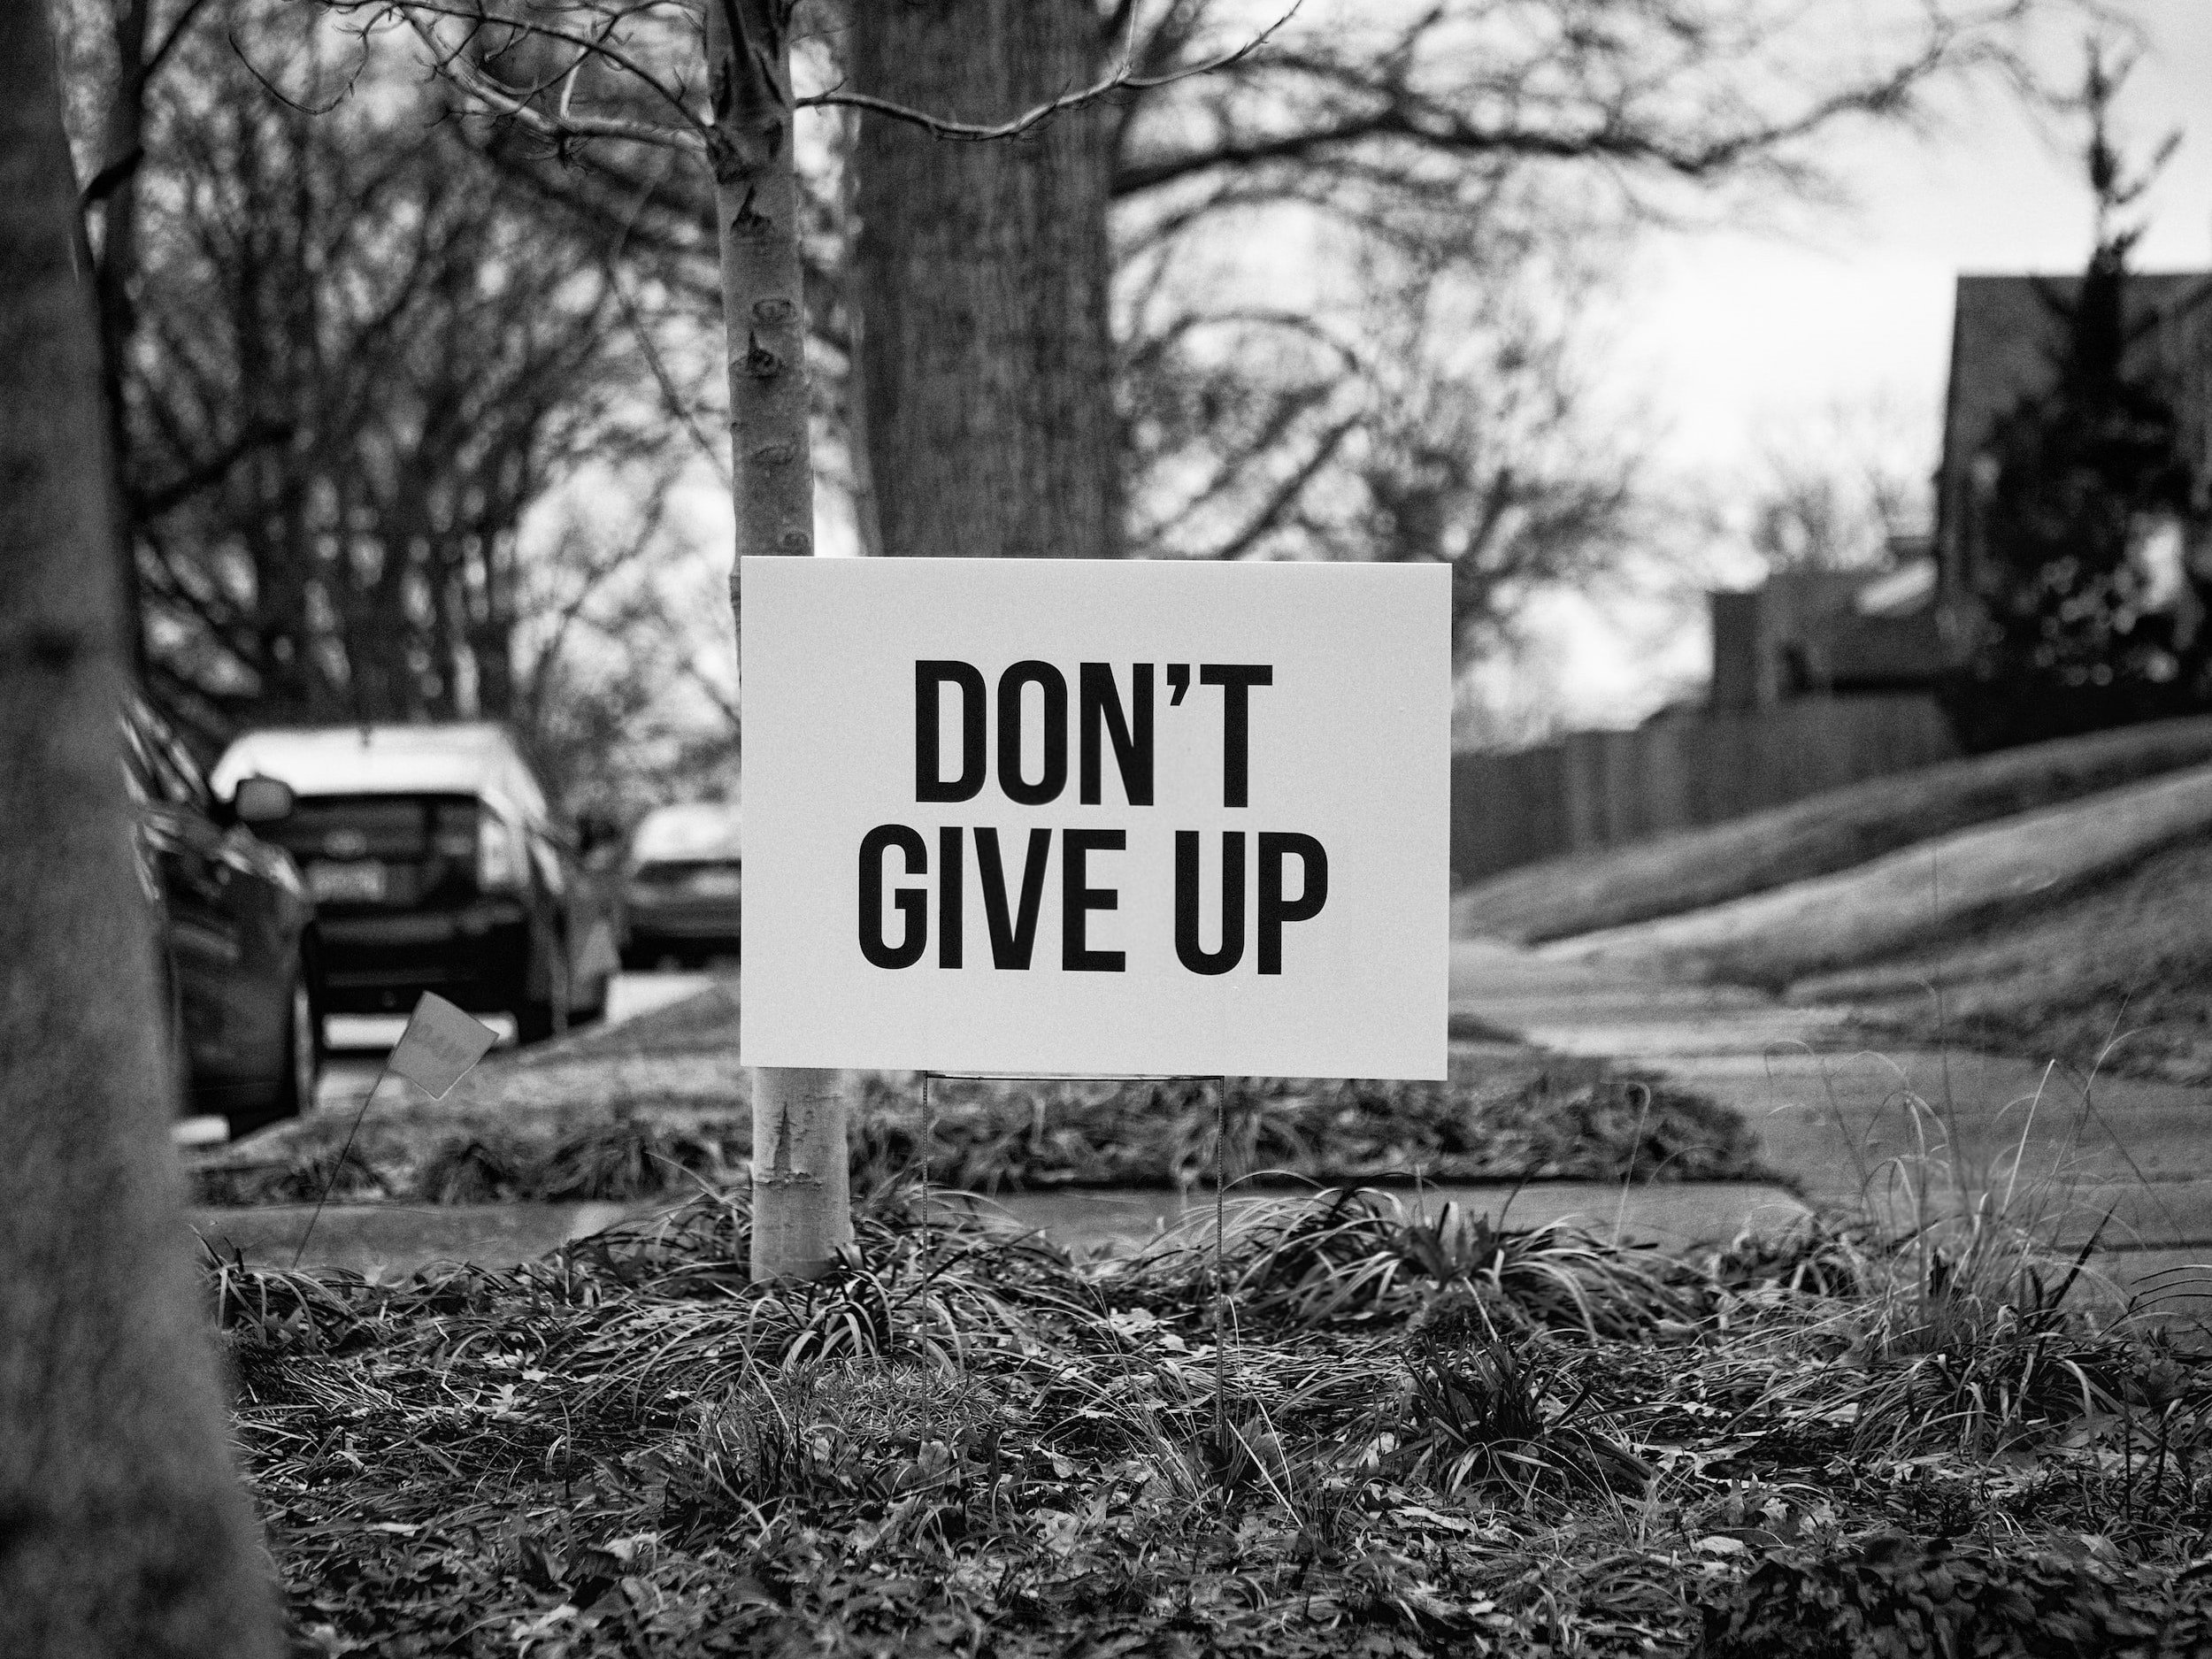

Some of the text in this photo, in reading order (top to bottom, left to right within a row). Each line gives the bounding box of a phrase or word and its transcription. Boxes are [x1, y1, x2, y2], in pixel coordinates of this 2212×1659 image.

[915, 659, 1273, 809] DON'T
[858, 824, 1328, 976] GIVE UP
